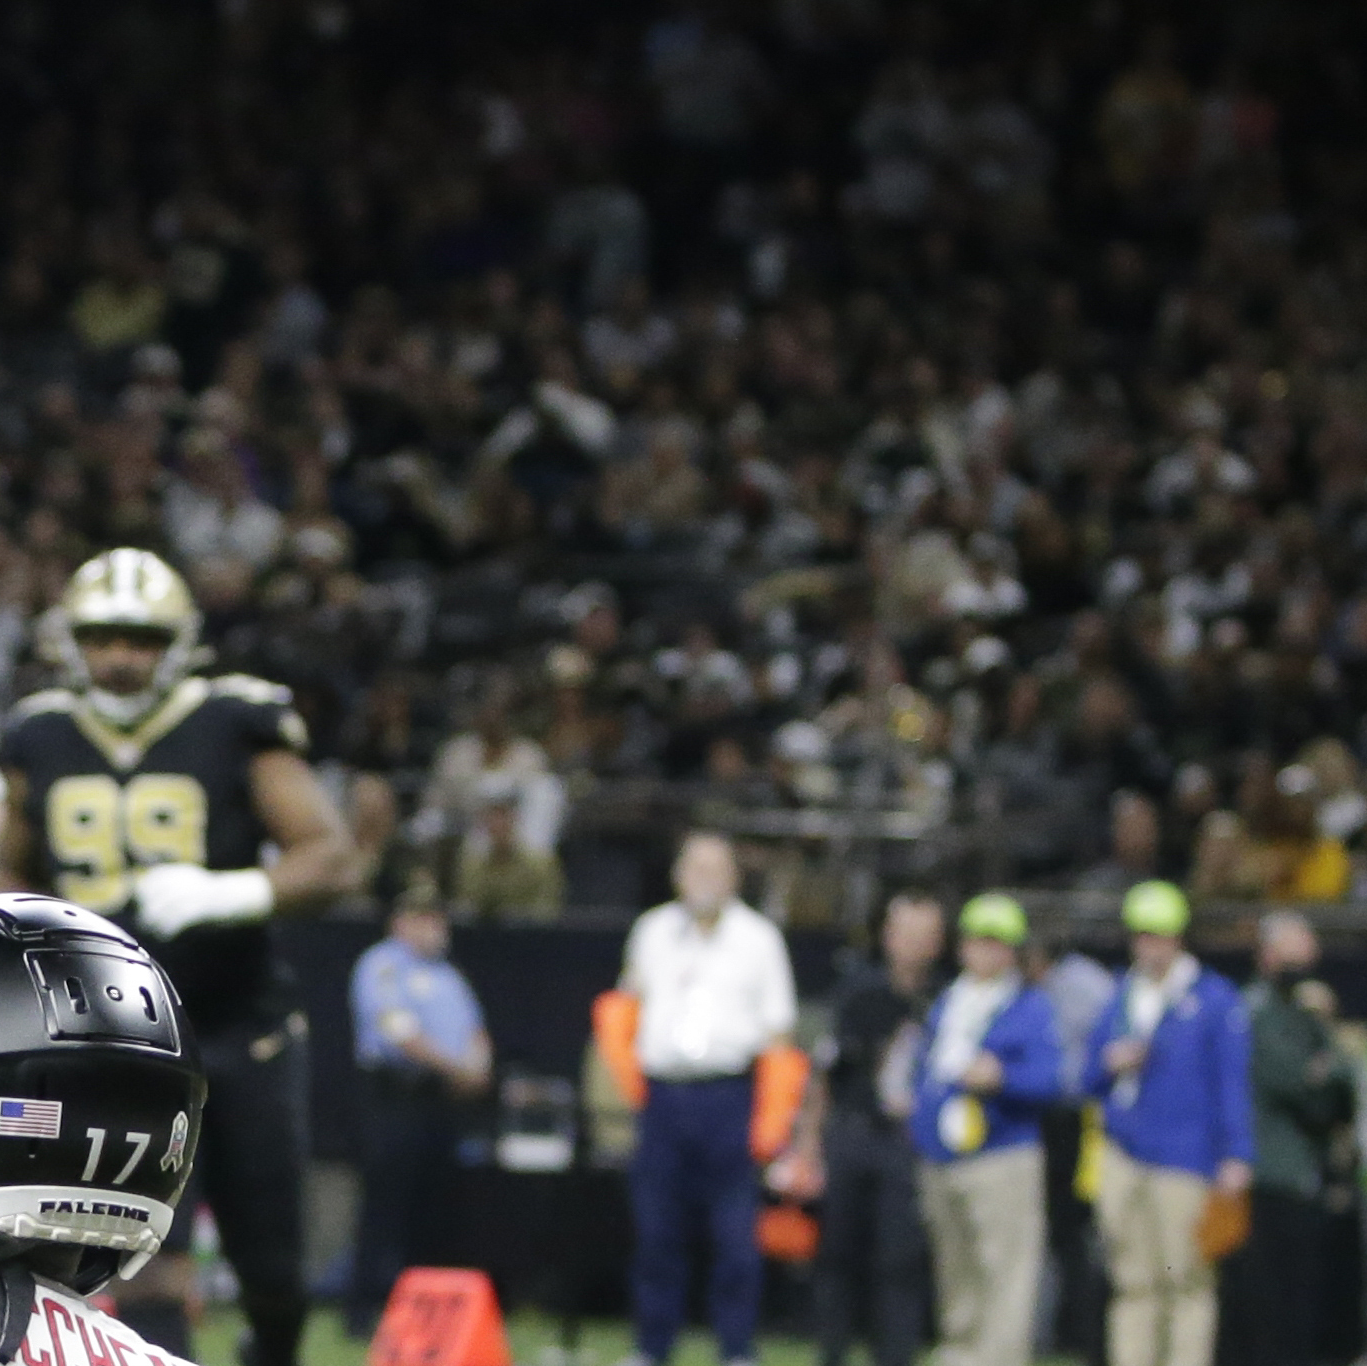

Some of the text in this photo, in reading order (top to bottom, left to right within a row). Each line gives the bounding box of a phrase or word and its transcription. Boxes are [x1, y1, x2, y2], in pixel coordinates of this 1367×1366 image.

[47, 772, 209, 916] 99
[81, 1127, 152, 1185] 17
[38, 1199, 150, 1223] FALCONS
